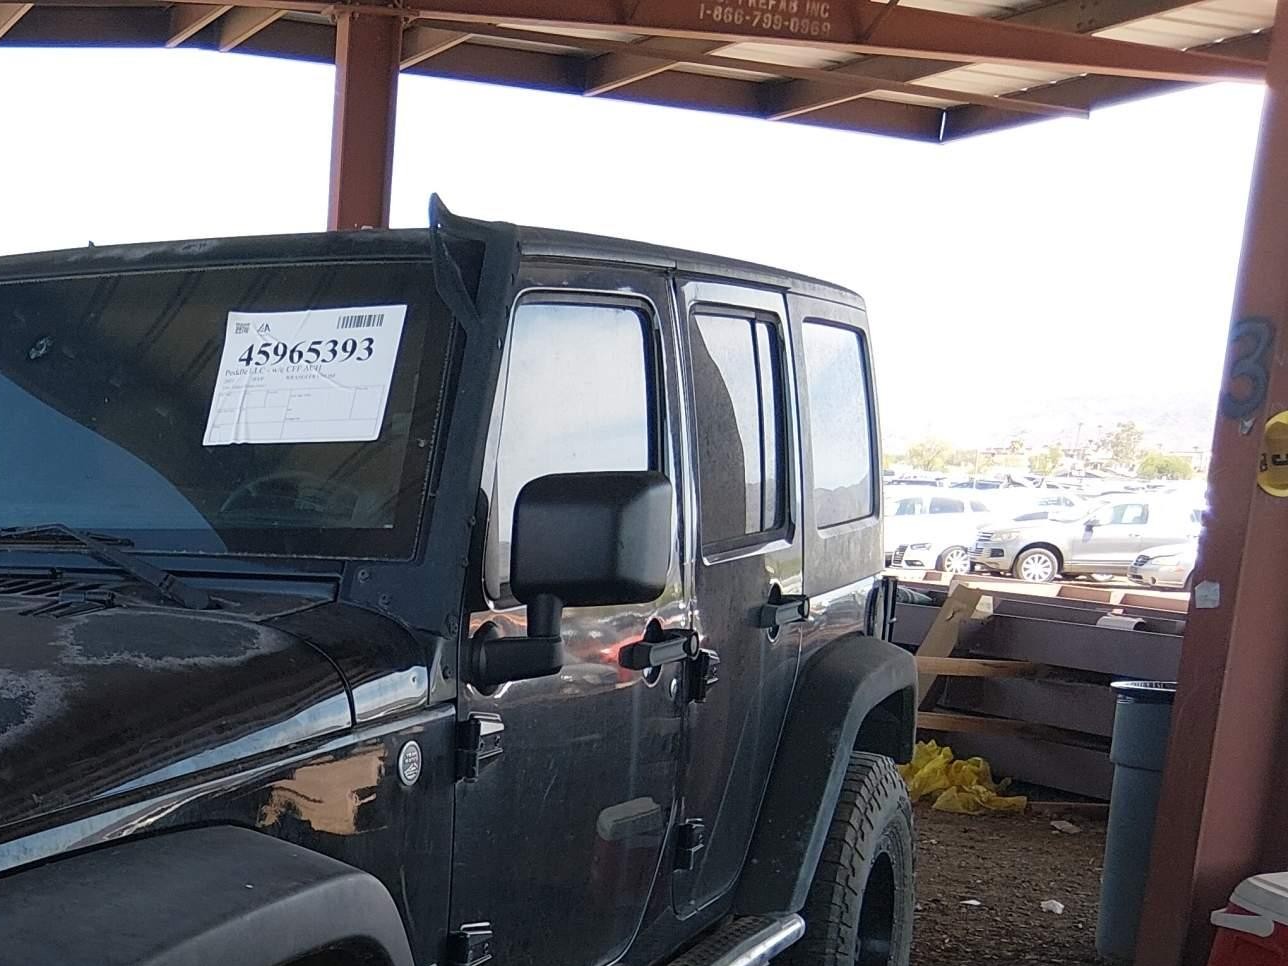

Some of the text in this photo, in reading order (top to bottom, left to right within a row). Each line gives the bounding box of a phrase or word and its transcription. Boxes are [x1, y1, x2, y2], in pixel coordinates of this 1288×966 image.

[805, 0, 830, 18] INC
[238, 337, 375, 367] 45965393
[1222, 320, 1273, 420] 3
